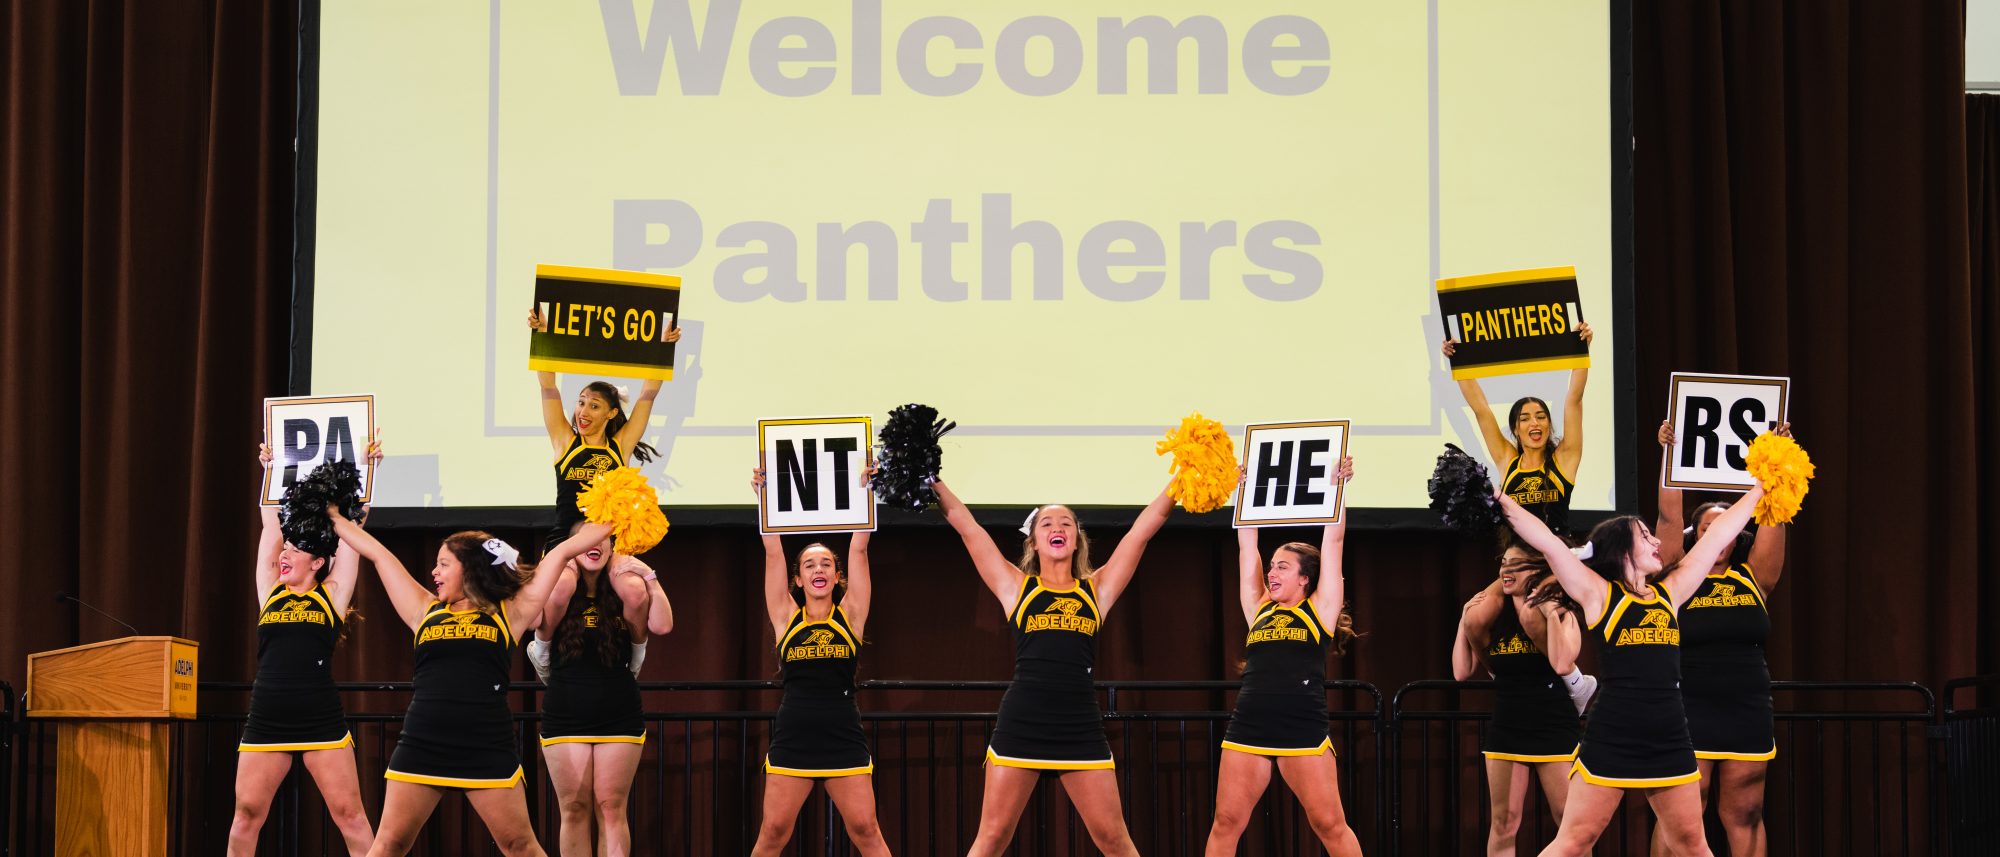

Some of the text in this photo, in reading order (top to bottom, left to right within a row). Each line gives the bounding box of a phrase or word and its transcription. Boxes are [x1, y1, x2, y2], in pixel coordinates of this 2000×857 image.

[600, 0, 1331, 97] Welcome
[612, 193, 1324, 303] Panthers
[623, 308, 656, 342] GO
[1461, 303, 1566, 343] PANTHERS
[282, 416, 357, 488] PA
[776, 437, 858, 512] NT
[1253, 439, 1330, 508] HE
[1685, 594, 1756, 609] ADELPHI
[259, 611, 325, 625] ADELPHI
[1025, 614, 1096, 636] ADELPHI
[419, 624, 498, 644] ADELPHI
[1247, 628, 1308, 646] ADELPHI
[1615, 627, 1680, 646] ADELPH
[786, 645, 849, 662] ADELPHI
